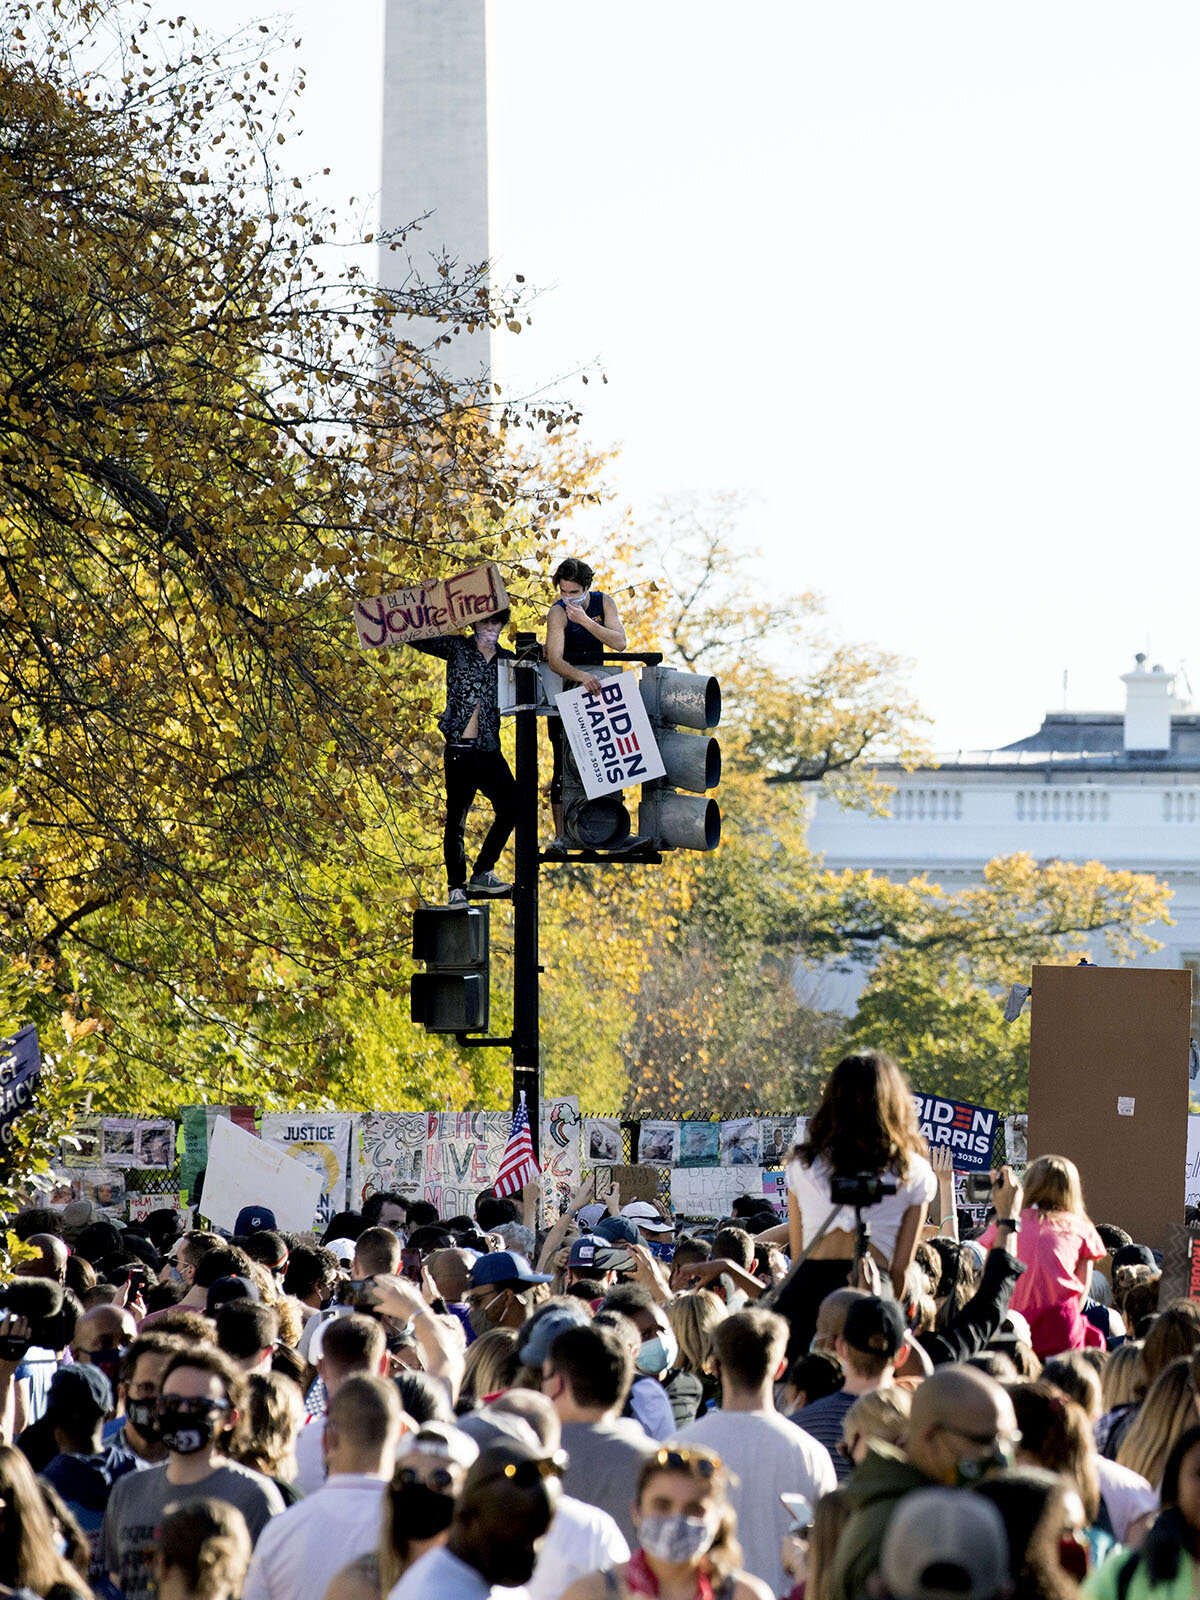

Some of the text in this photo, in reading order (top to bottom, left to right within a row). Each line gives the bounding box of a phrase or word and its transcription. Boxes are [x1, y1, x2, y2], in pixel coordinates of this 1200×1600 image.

[387, 592, 416, 608] BLM
[581, 692, 625, 784] HARRIS
[601, 682, 647, 778] BIDEN
[577, 717, 593, 749] UNITED
[590, 757, 604, 783] 30330
[283, 1127, 334, 1140] JUSTICE
[426, 1112, 507, 1141] BLACK
[919, 1123, 990, 1155] ARRIS
[957, 1152, 983, 1165] 30330
[688, 1176, 746, 1196] LIVES
[685, 1198, 730, 1213] MATT
